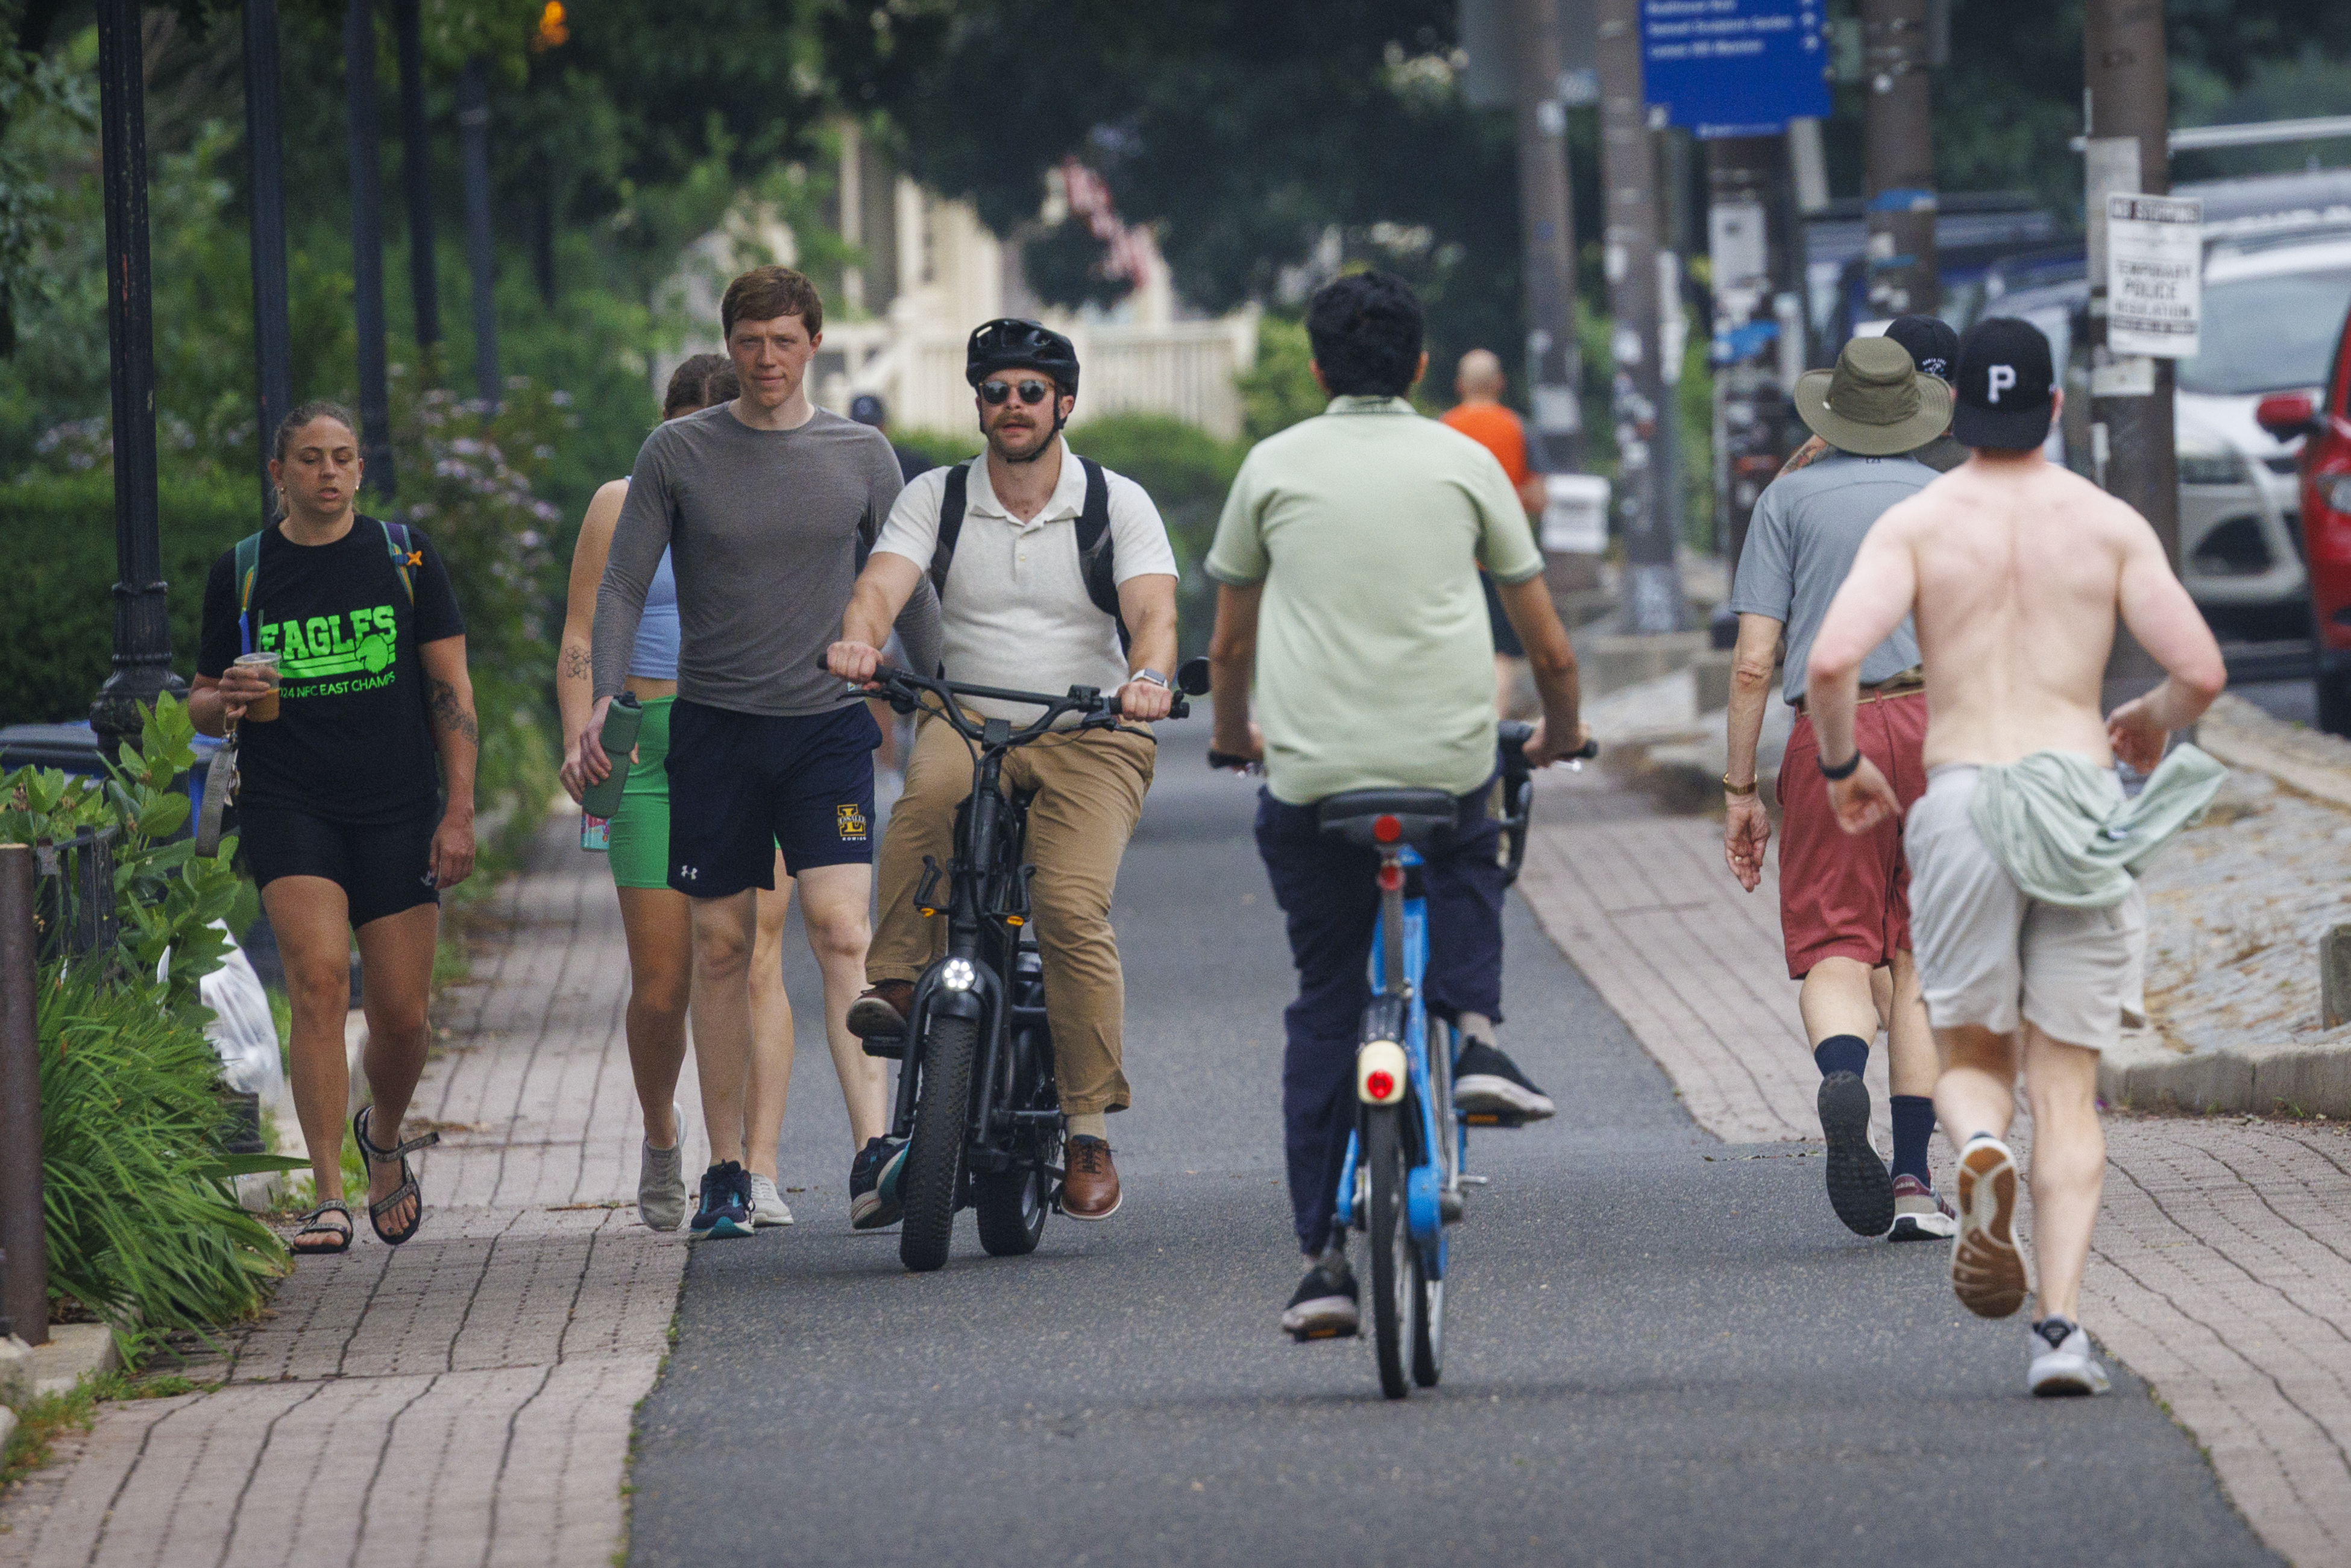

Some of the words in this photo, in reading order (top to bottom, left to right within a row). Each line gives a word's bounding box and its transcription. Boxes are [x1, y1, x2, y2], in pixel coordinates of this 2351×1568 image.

[2123, 279, 2176, 299] POLICE
[1988, 365, 2016, 403] P
[260, 605, 397, 661] EAGLES
[297, 685, 318, 698] NFC
[319, 681, 349, 696] EAST
[351, 671, 396, 692] CHAMPS
